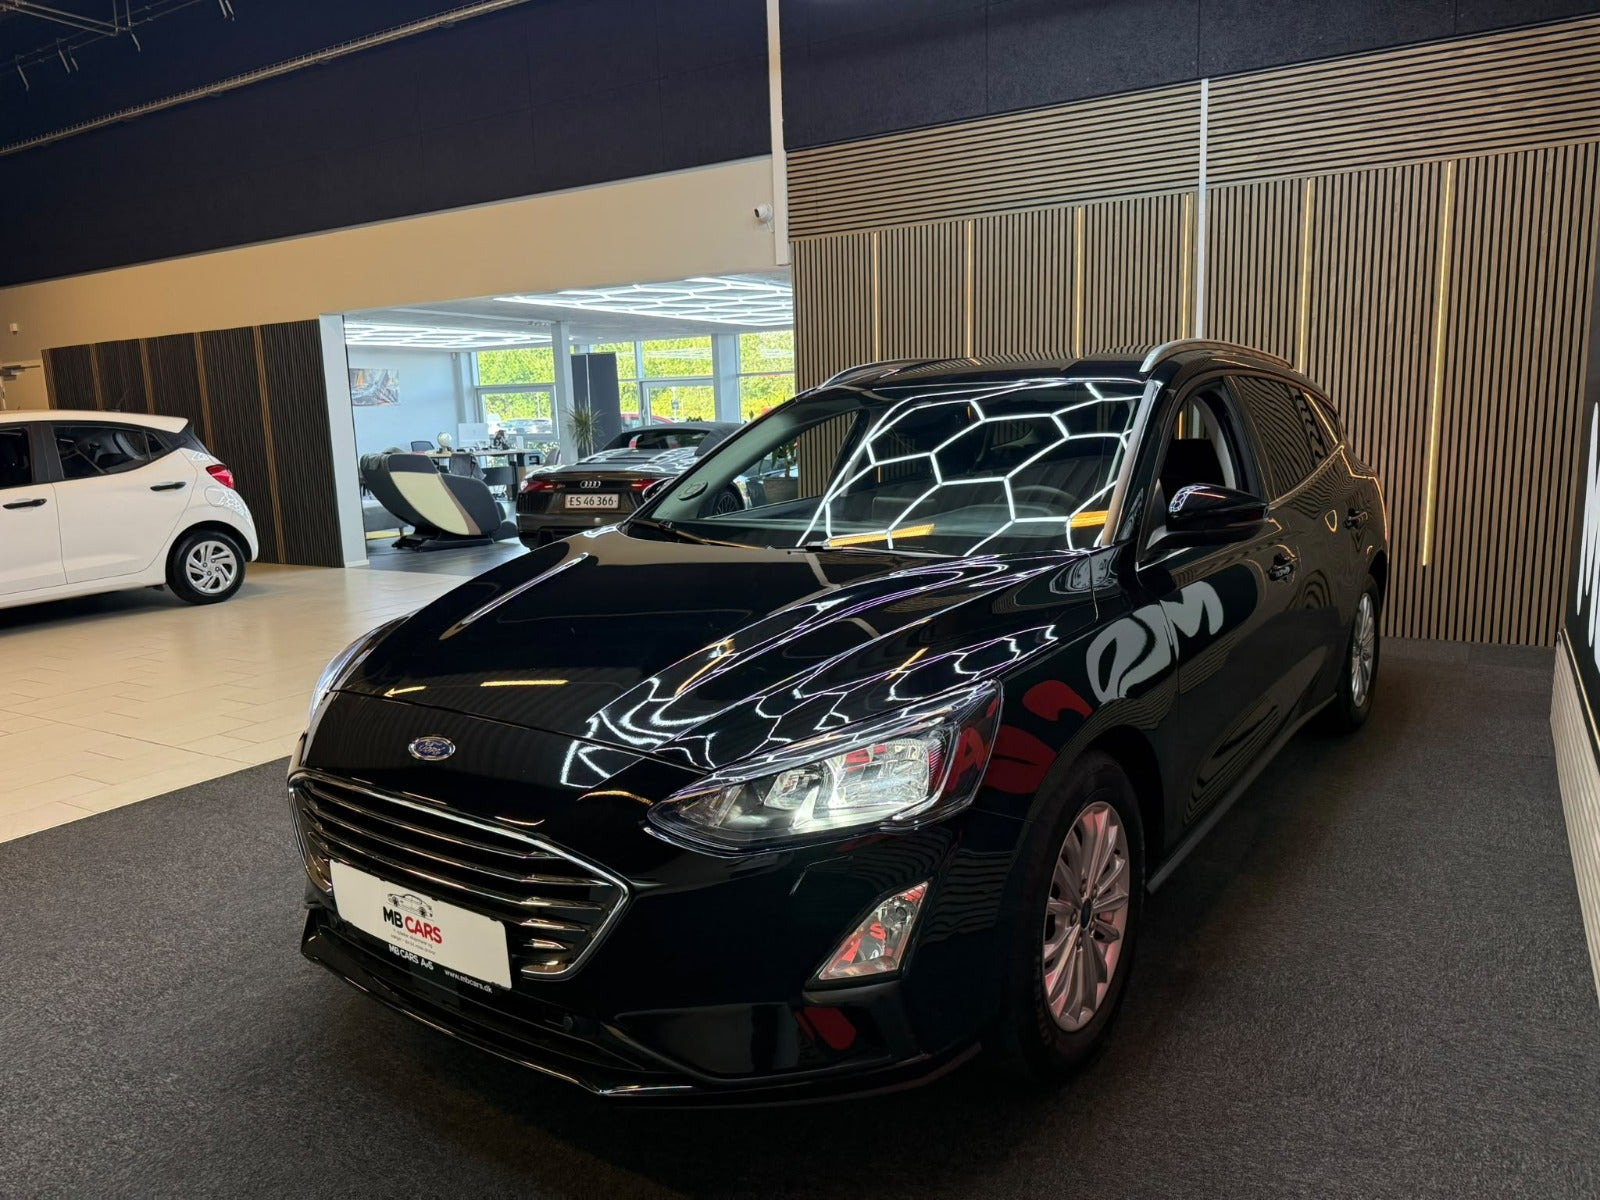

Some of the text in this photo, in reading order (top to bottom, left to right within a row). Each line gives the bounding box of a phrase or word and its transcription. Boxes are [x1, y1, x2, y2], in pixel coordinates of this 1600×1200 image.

[569, 496, 614, 506] ES 46 366
[383, 906, 404, 928] MB
[405, 916, 442, 944] CARS
[388, 944, 400, 956] MB
[400, 949, 419, 964] CARS
[444, 969, 493, 994] www.mbcars.dk
